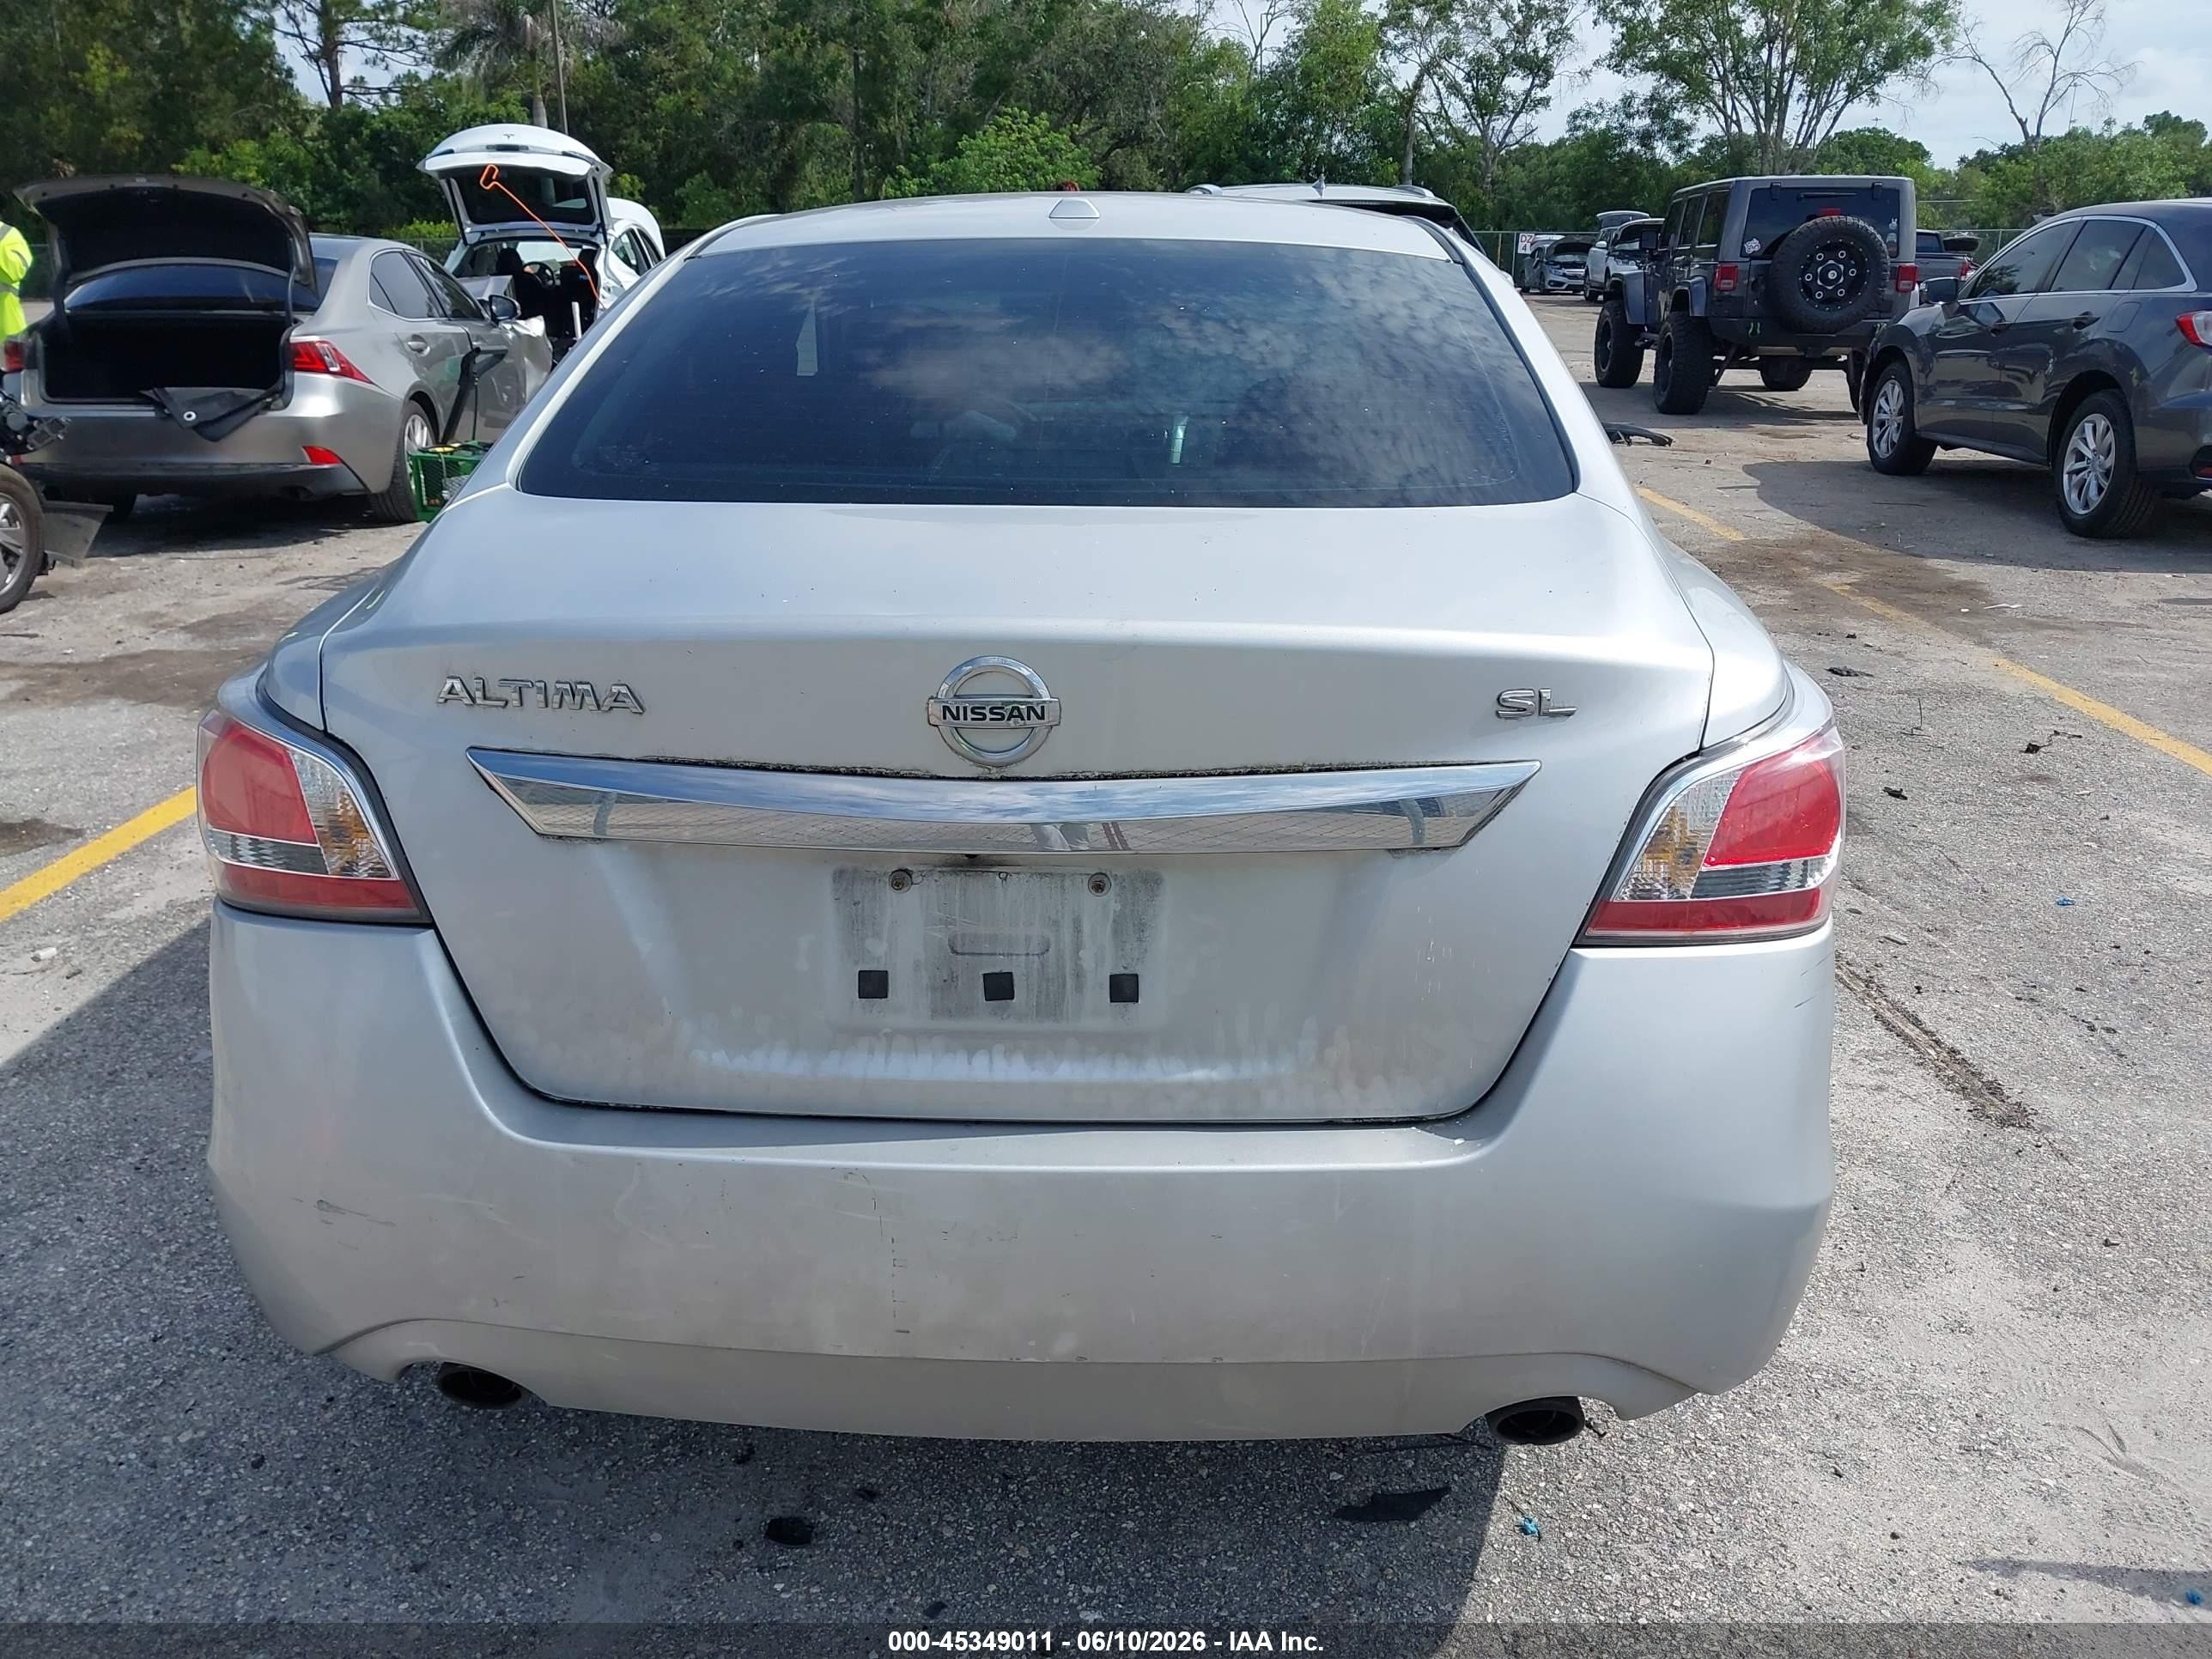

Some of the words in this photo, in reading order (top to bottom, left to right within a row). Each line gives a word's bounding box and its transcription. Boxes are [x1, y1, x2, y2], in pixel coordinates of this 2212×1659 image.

[436, 675, 645, 714] ALTIMA
[1496, 688, 1578, 720] SL
[942, 705, 1046, 721] NISSAN
